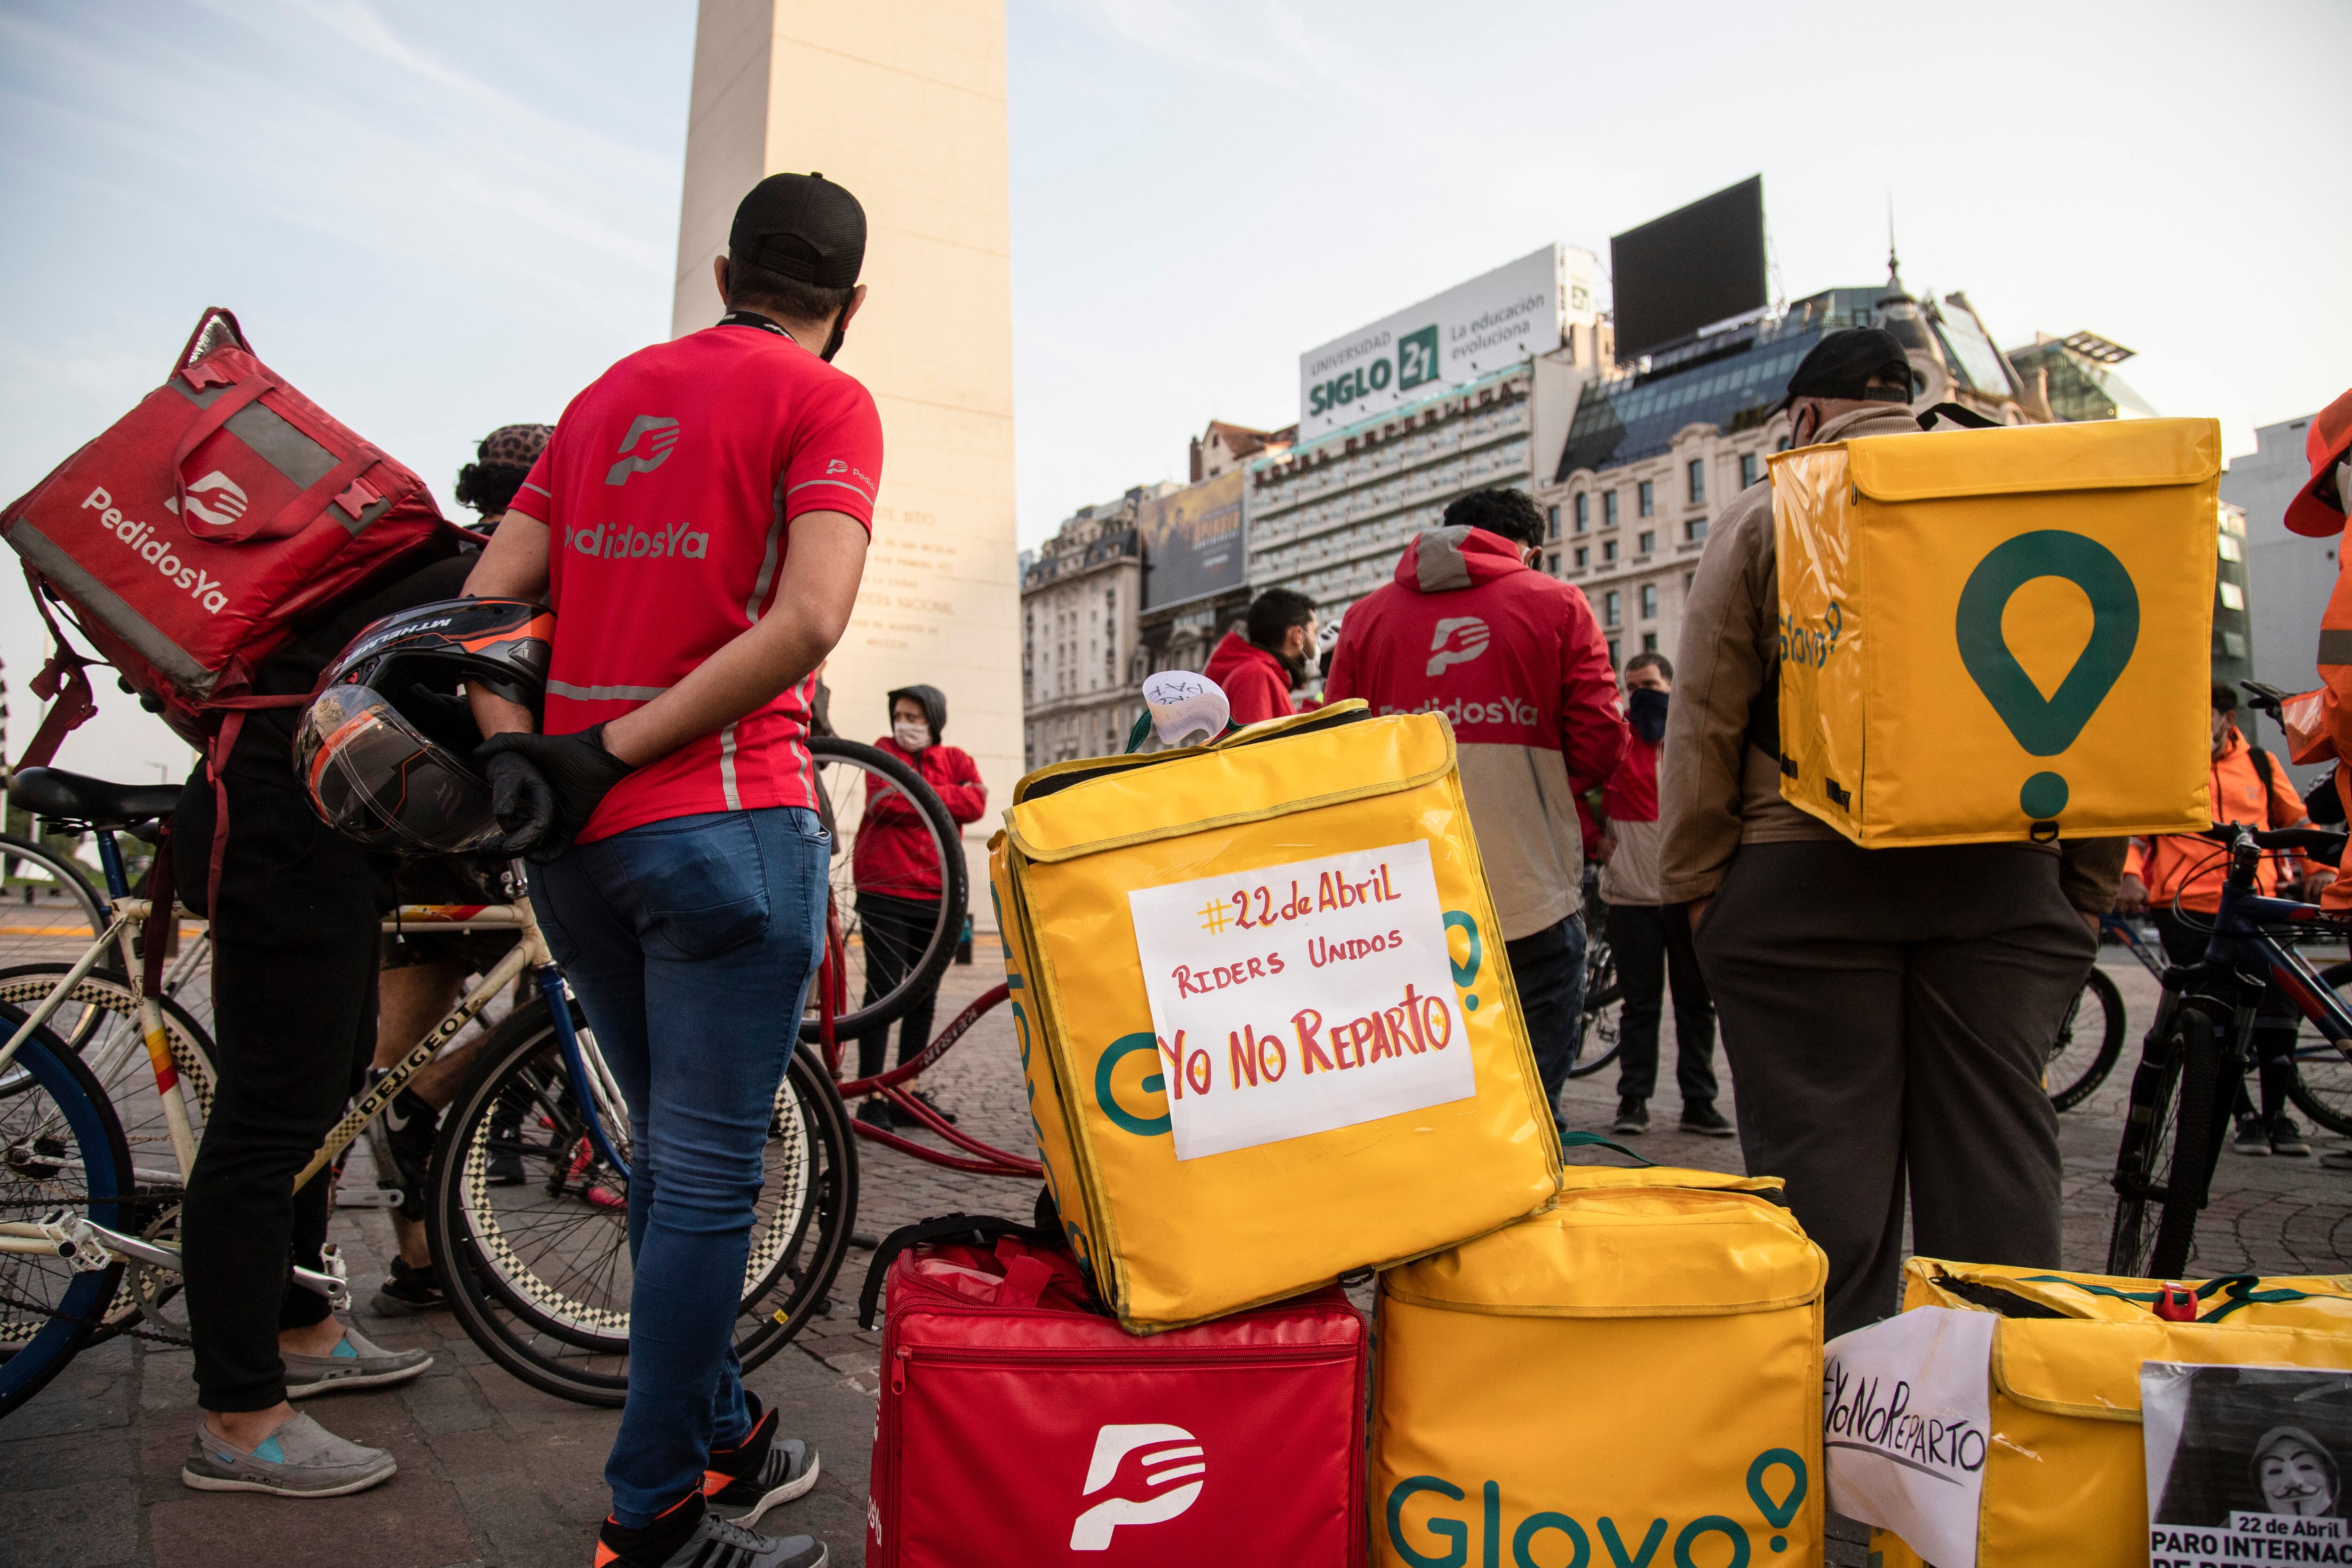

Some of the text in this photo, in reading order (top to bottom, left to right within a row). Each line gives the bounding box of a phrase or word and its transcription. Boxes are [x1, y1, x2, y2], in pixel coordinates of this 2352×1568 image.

[1450, 294, 1545, 342] La educación
[1452, 320, 1531, 359] evoluciona
[1310, 331, 1391, 375] UNIVERSIDAD
[1310, 340, 1432, 417] SIGLO 21
[80, 486, 229, 614] PedidosYa
[564, 522, 709, 559] didosYa
[1172, 929, 1403, 1000] RIDERS UNIDOS
[359, 1003, 473, 1116] PEUGEOT
[1228, 1024, 1287, 1091] NO
[2151, 1531, 2218, 1555] PARO
[2238, 1516, 2341, 1538] 22 de Abril
